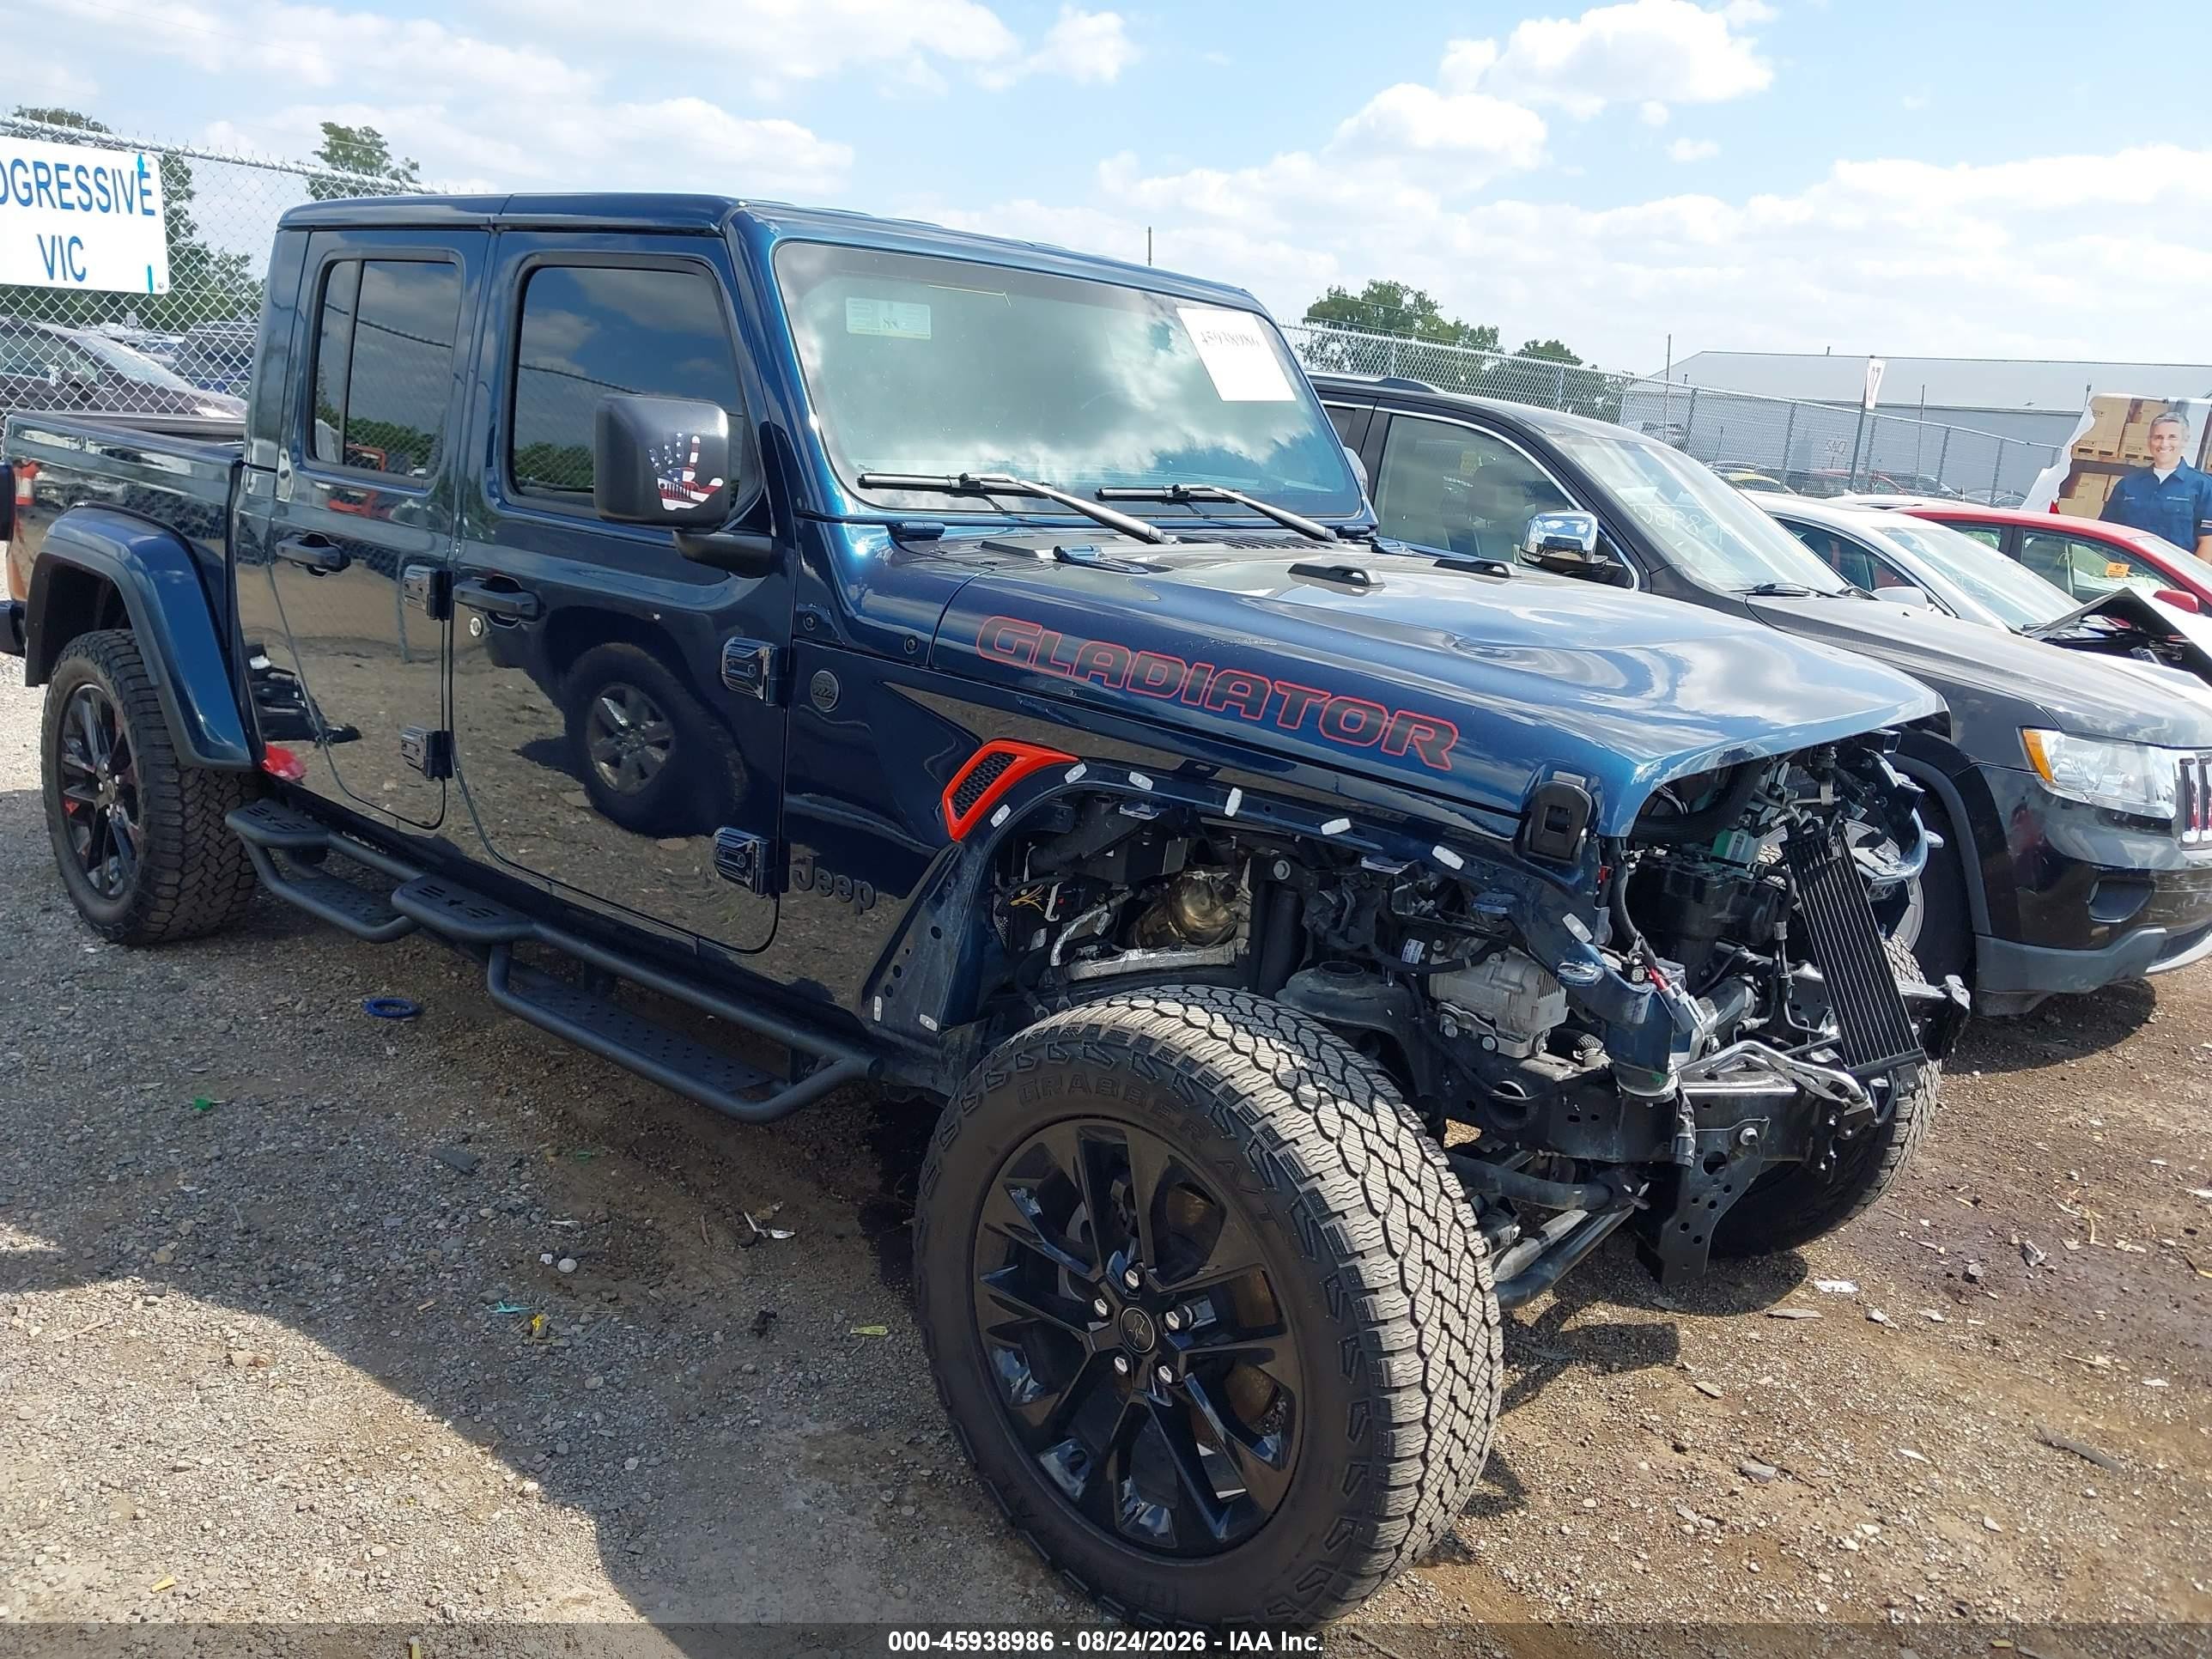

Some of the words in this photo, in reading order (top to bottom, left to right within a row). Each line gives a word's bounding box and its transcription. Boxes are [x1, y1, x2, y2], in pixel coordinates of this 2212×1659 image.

[36, 234, 87, 283] VIC
[976, 616, 1458, 770] GLADIATOR
[792, 855, 877, 915] Jeep
[1018, 1073, 1209, 1147] GRABBER
